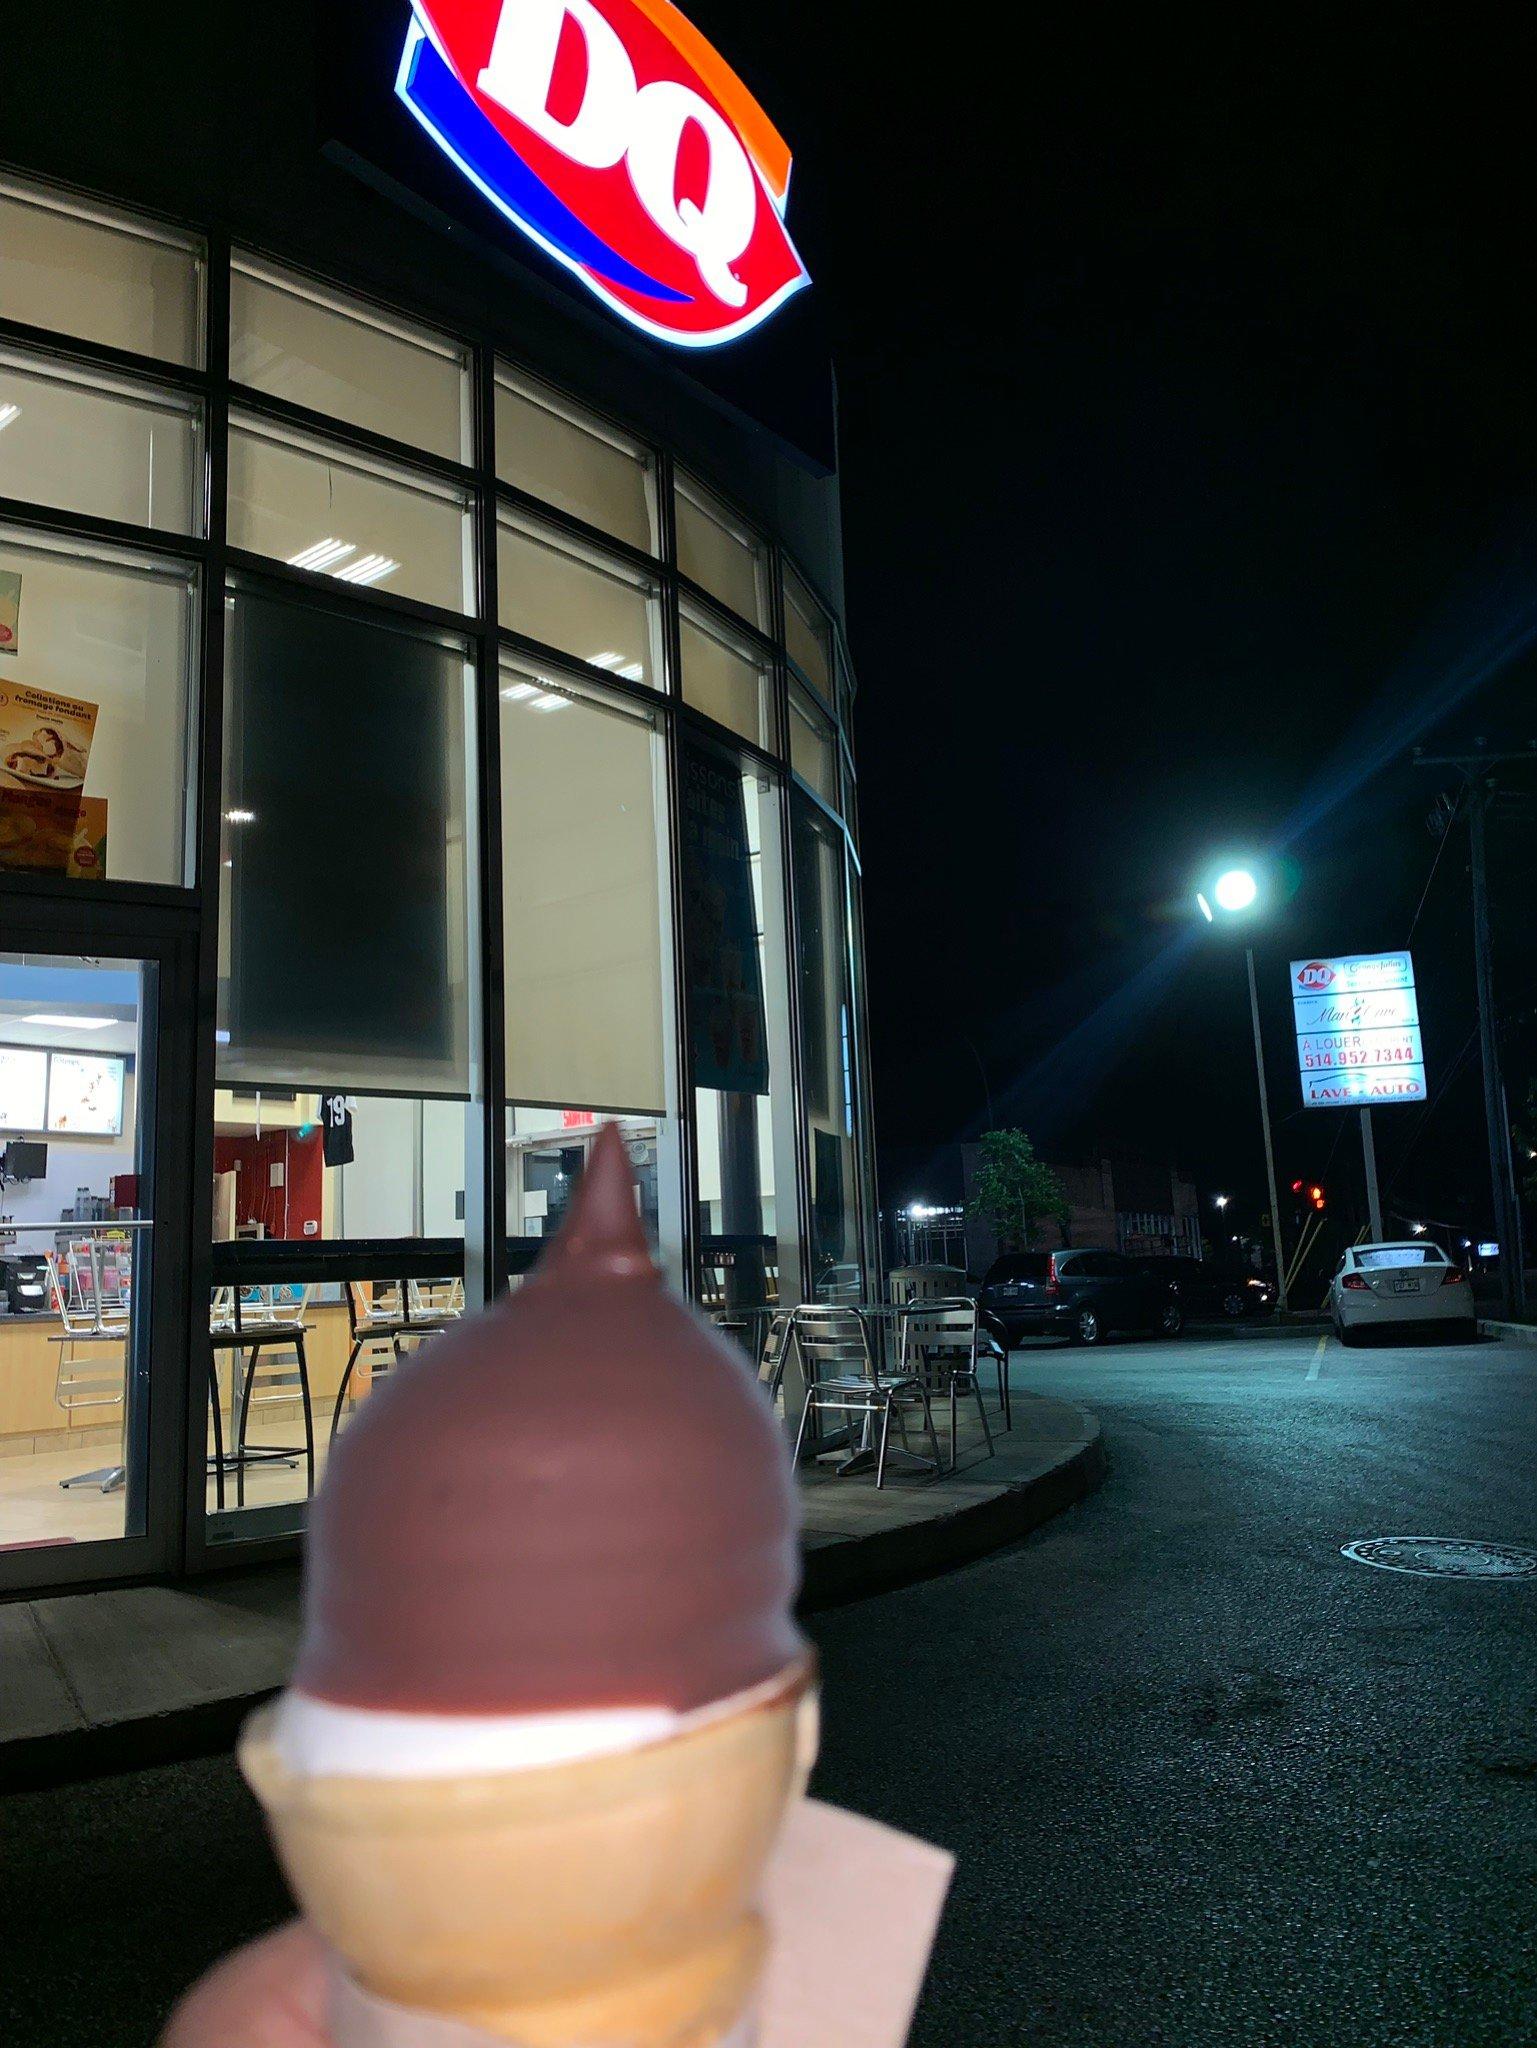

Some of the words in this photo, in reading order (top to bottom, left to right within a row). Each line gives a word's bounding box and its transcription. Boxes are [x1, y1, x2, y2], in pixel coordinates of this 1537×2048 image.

[476, 0, 758, 308] DQ
[15, 694, 54, 711] fromage
[55, 706, 92, 720] fondant
[1303, 967, 1333, 986] DQ
[1316, 1036, 1361, 1050] LOUER
[1311, 1087, 1352, 1100] LAVE
[1371, 1082, 1420, 1096] AUTO
[326, 1095, 346, 1128] 19
